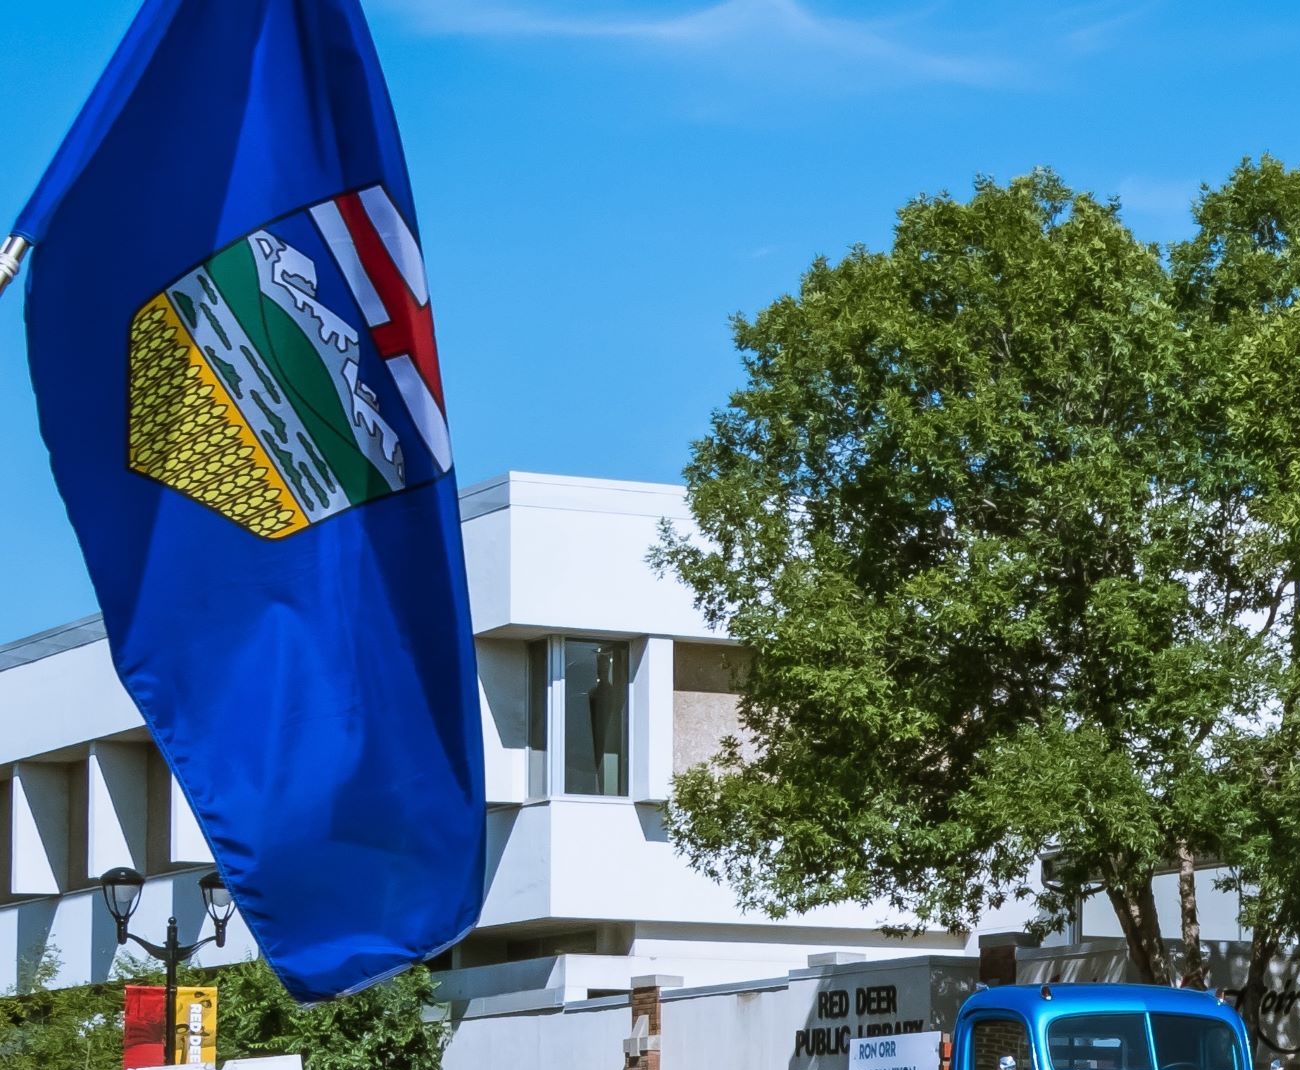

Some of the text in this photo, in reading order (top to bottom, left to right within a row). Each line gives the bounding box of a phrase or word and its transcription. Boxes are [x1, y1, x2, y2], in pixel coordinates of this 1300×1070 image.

[817, 984, 898, 1019] RED DEER
[189, 1003, 203, 1035] RED
[795, 1025, 851, 1058] PUBLIC
[859, 1040, 897, 1060] RON ORR
